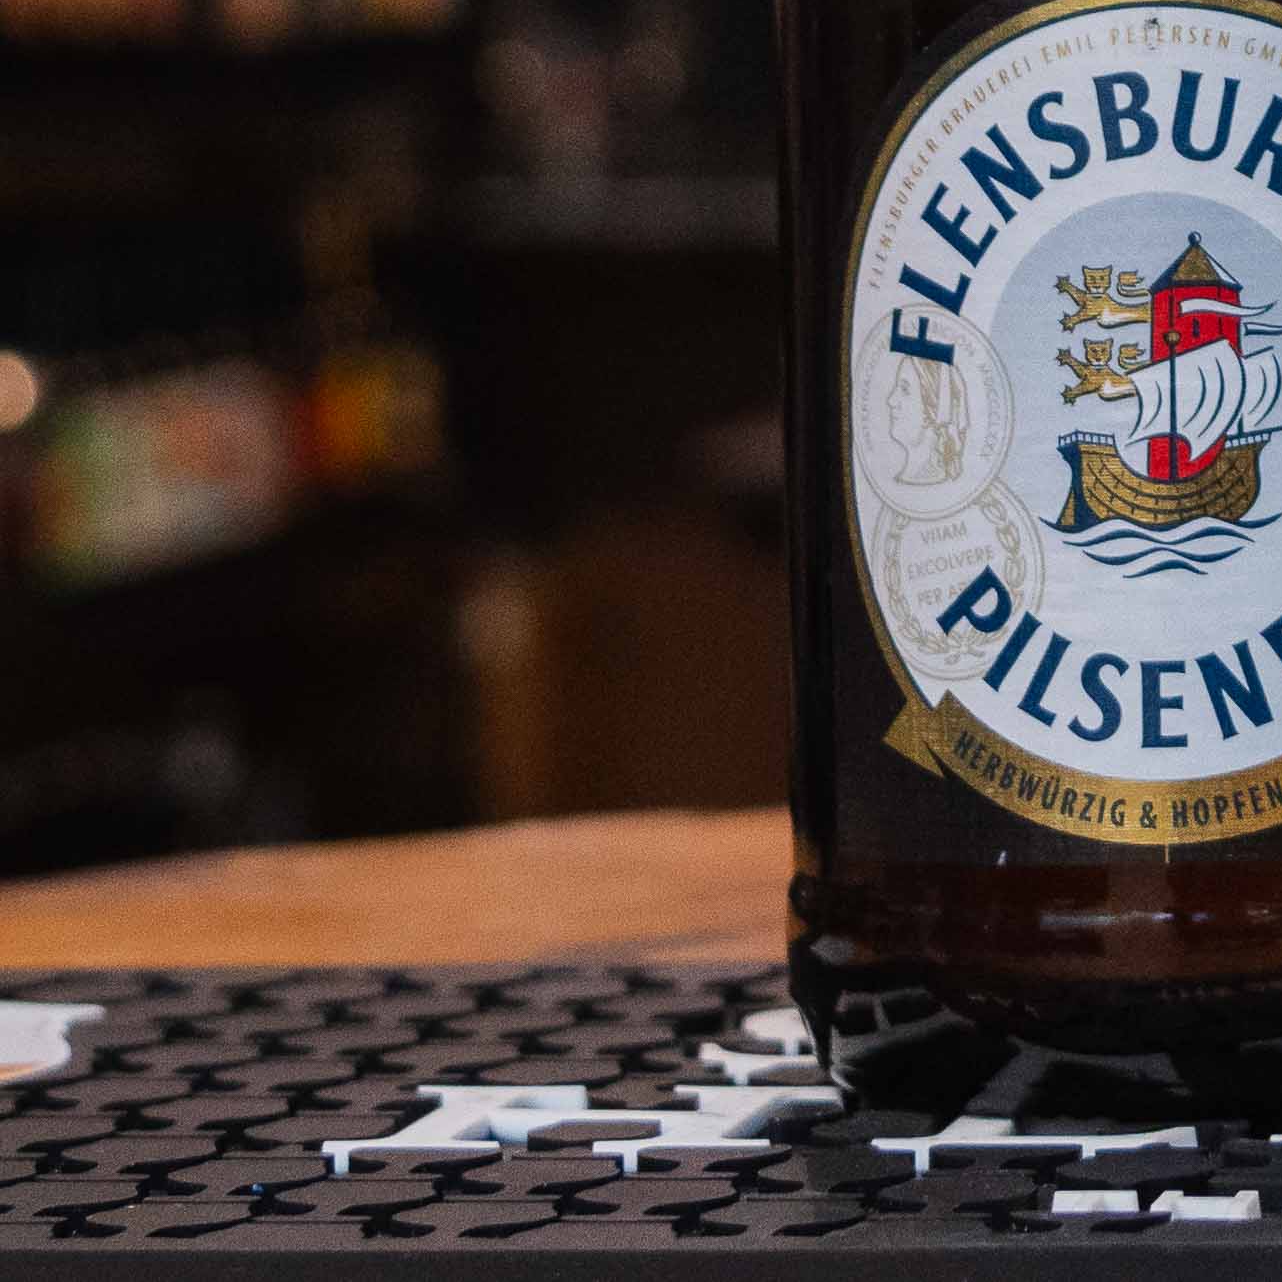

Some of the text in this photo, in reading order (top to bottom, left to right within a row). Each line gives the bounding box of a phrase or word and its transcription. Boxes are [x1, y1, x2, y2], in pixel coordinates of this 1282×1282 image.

[939, 55, 1033, 136] BRAUEREI
[1040, 34, 1094, 65] EMIL
[952, 730, 1127, 829] HERBWÜRZIG
[1138, 803, 1159, 830] &
